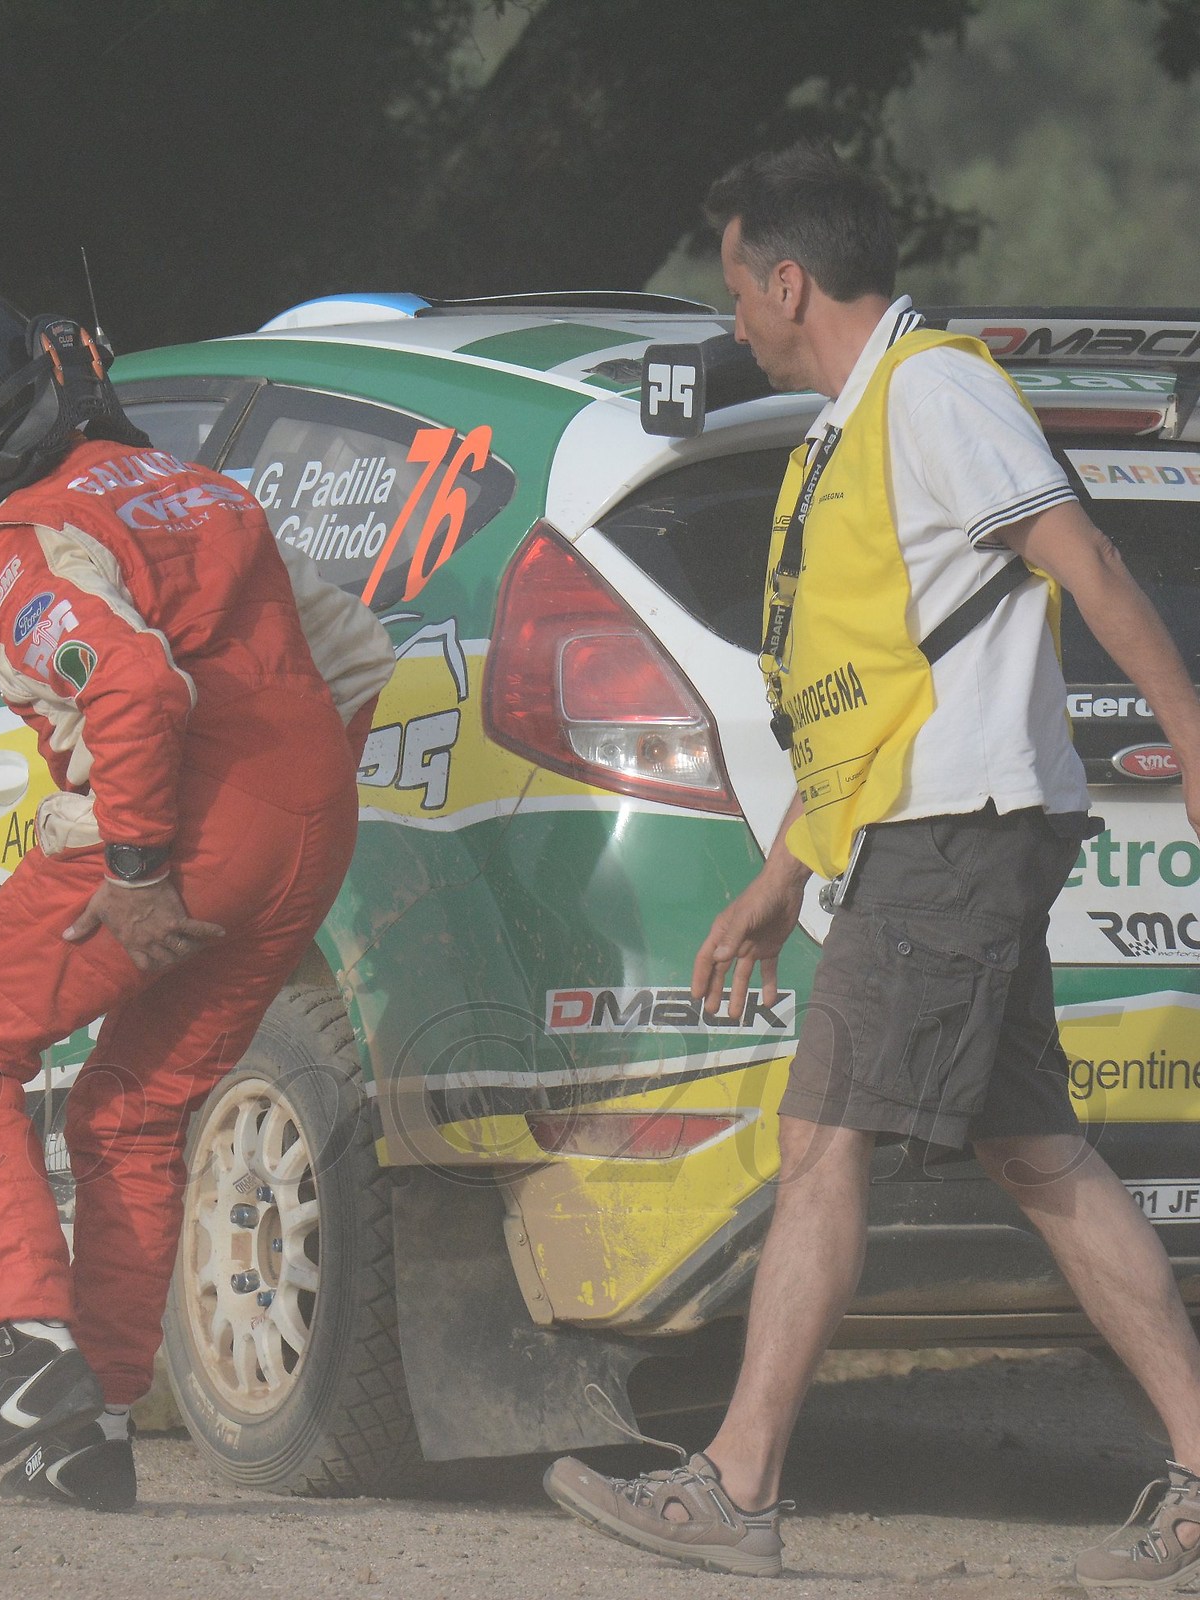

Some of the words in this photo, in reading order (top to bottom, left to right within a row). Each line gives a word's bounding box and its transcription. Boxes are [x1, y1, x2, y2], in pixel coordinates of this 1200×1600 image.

[980, 328, 1200, 357] DMAC
[291, 457, 397, 508] Padilla
[798, 464, 822, 524] ABARTH
[276, 512, 386, 560] Galindo
[361, 425, 492, 607] 76
[19, 602, 47, 637] Ford
[26, 1450, 43, 1476] OMP
